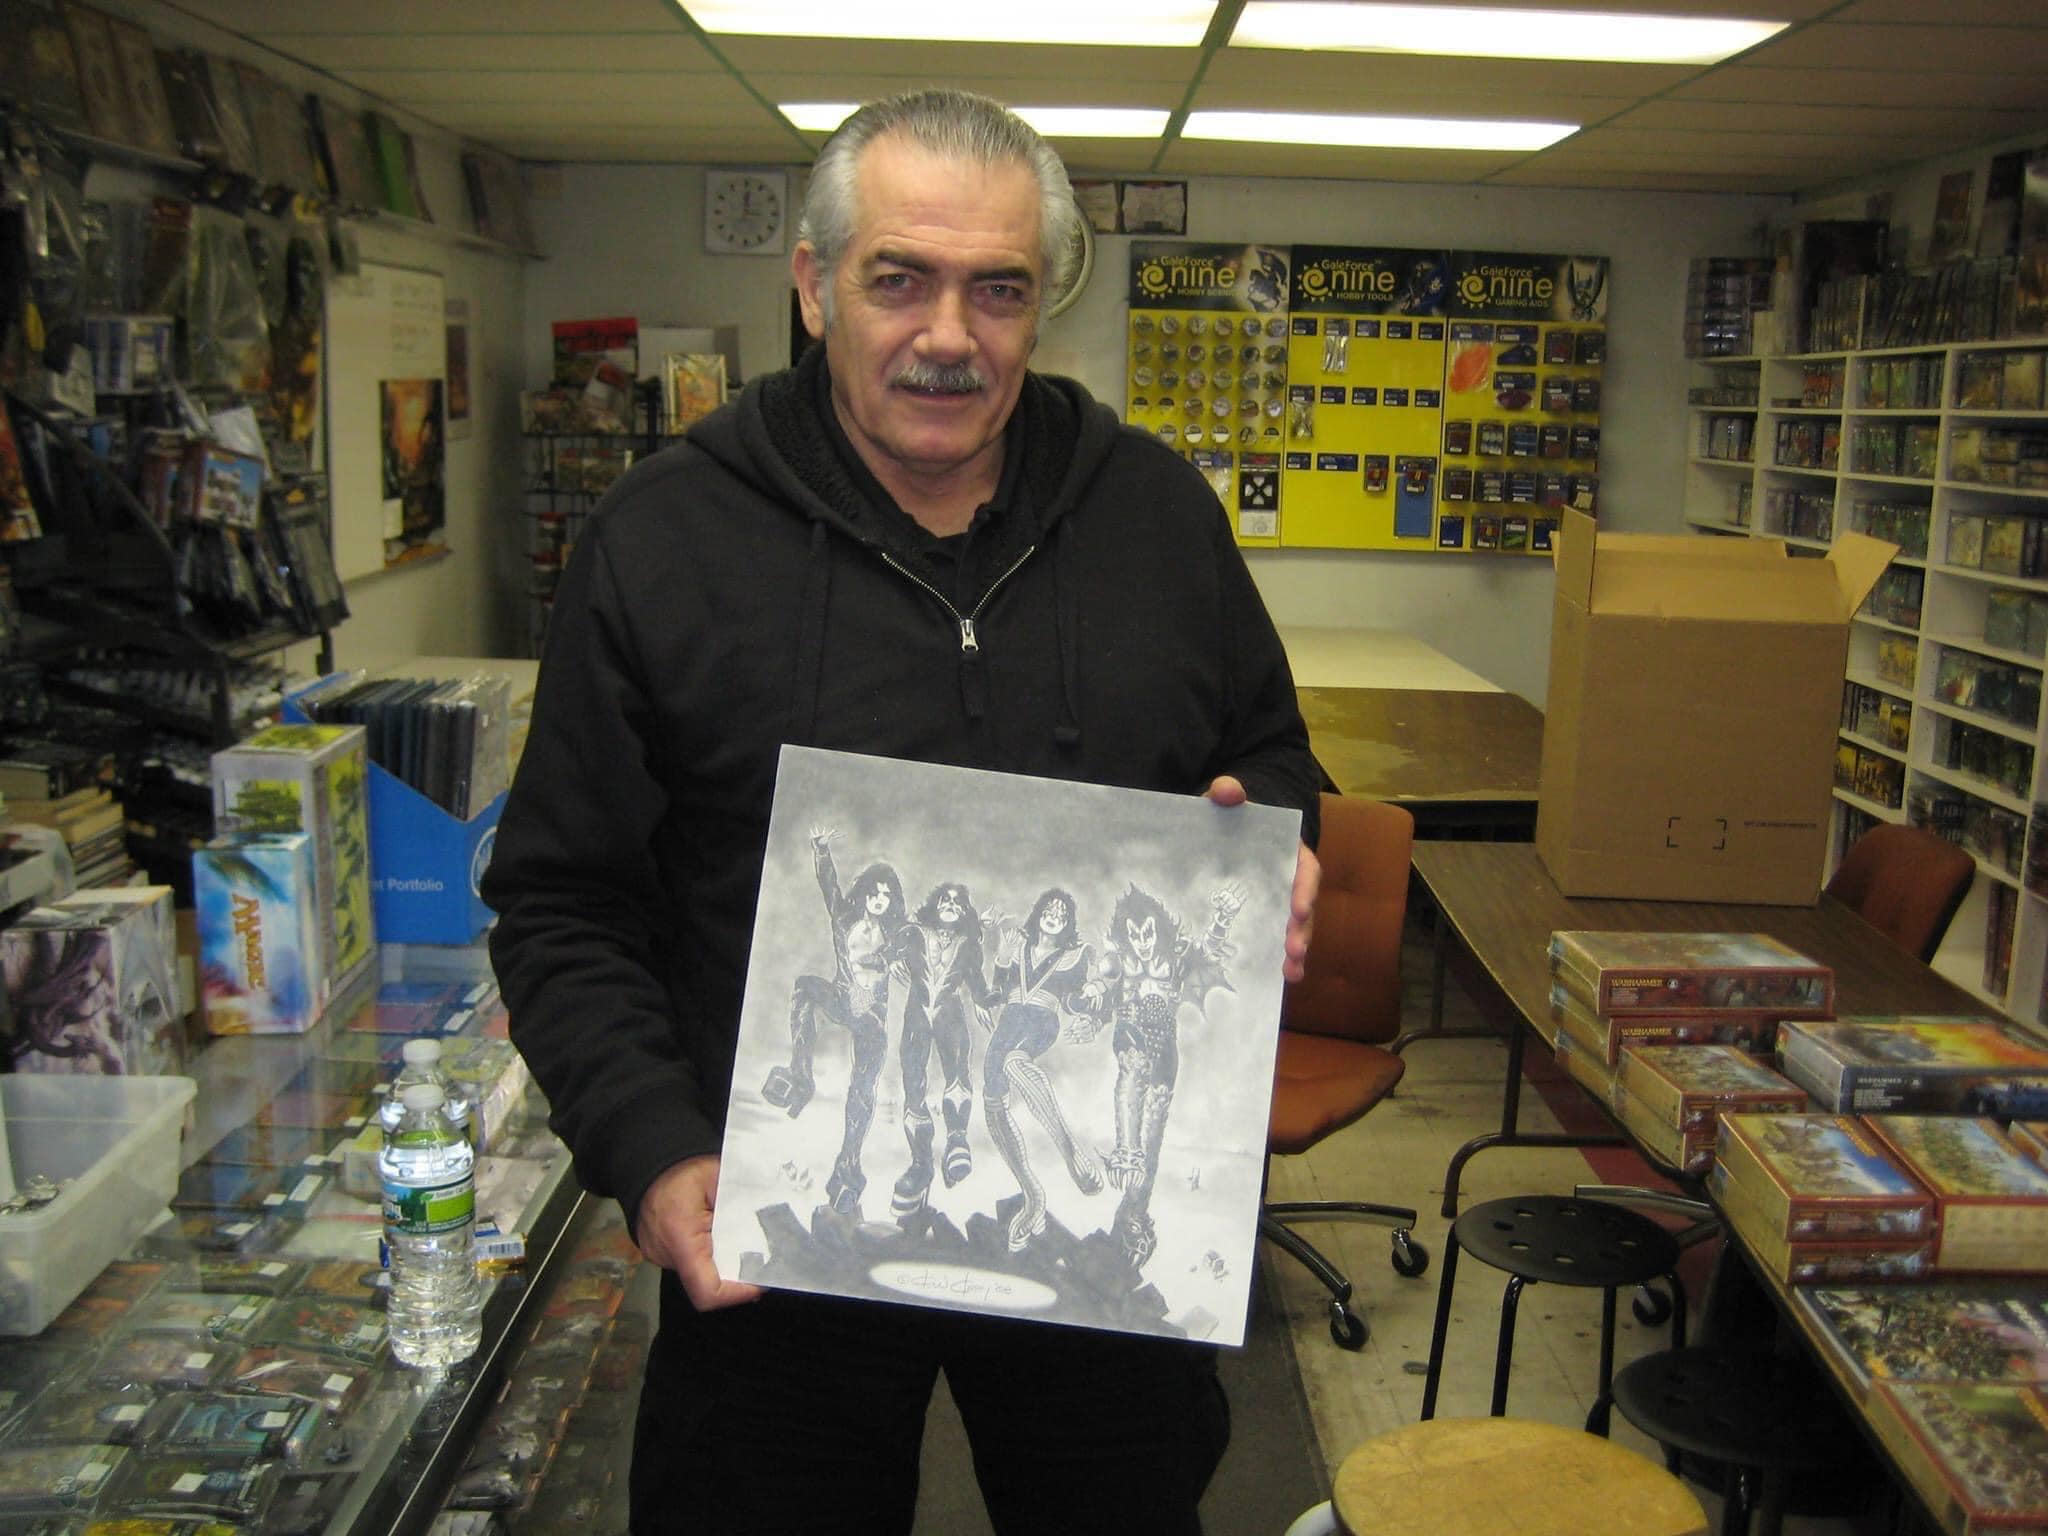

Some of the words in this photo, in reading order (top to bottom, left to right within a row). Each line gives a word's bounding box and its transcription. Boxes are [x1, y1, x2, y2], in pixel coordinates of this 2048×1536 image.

[1160, 255, 1214, 267] GaleForce
[1321, 258, 1374, 272] GaleForce
[1171, 265, 1236, 288] nine
[1480, 265, 1533, 278] GaleForce
[1331, 270, 1396, 292] nine
[1490, 275, 1553, 298] nine
[387, 879, 443, 891] Portfolio
